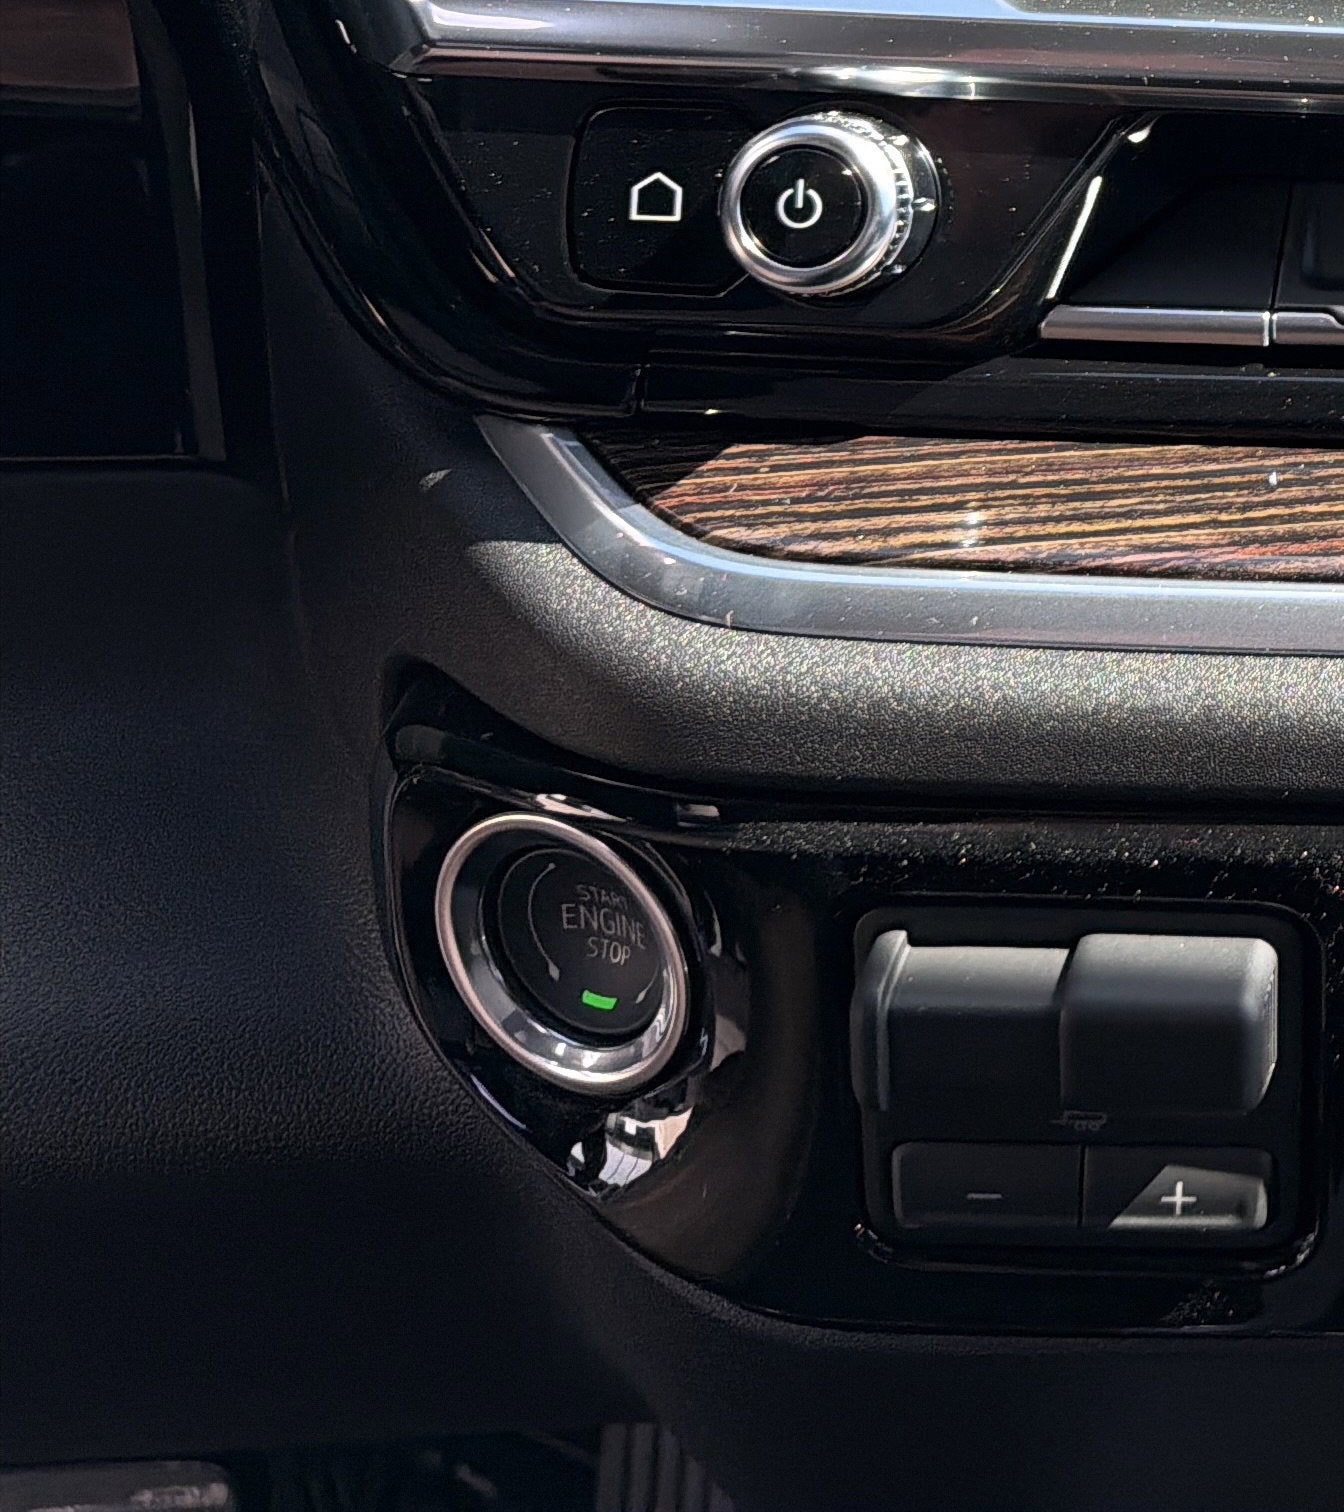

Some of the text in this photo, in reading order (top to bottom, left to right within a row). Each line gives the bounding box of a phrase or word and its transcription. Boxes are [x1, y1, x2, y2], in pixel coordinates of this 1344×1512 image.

[576, 884, 628, 909] START
[562, 903, 646, 950] ENGINE
[587, 936, 631, 966] STOP
